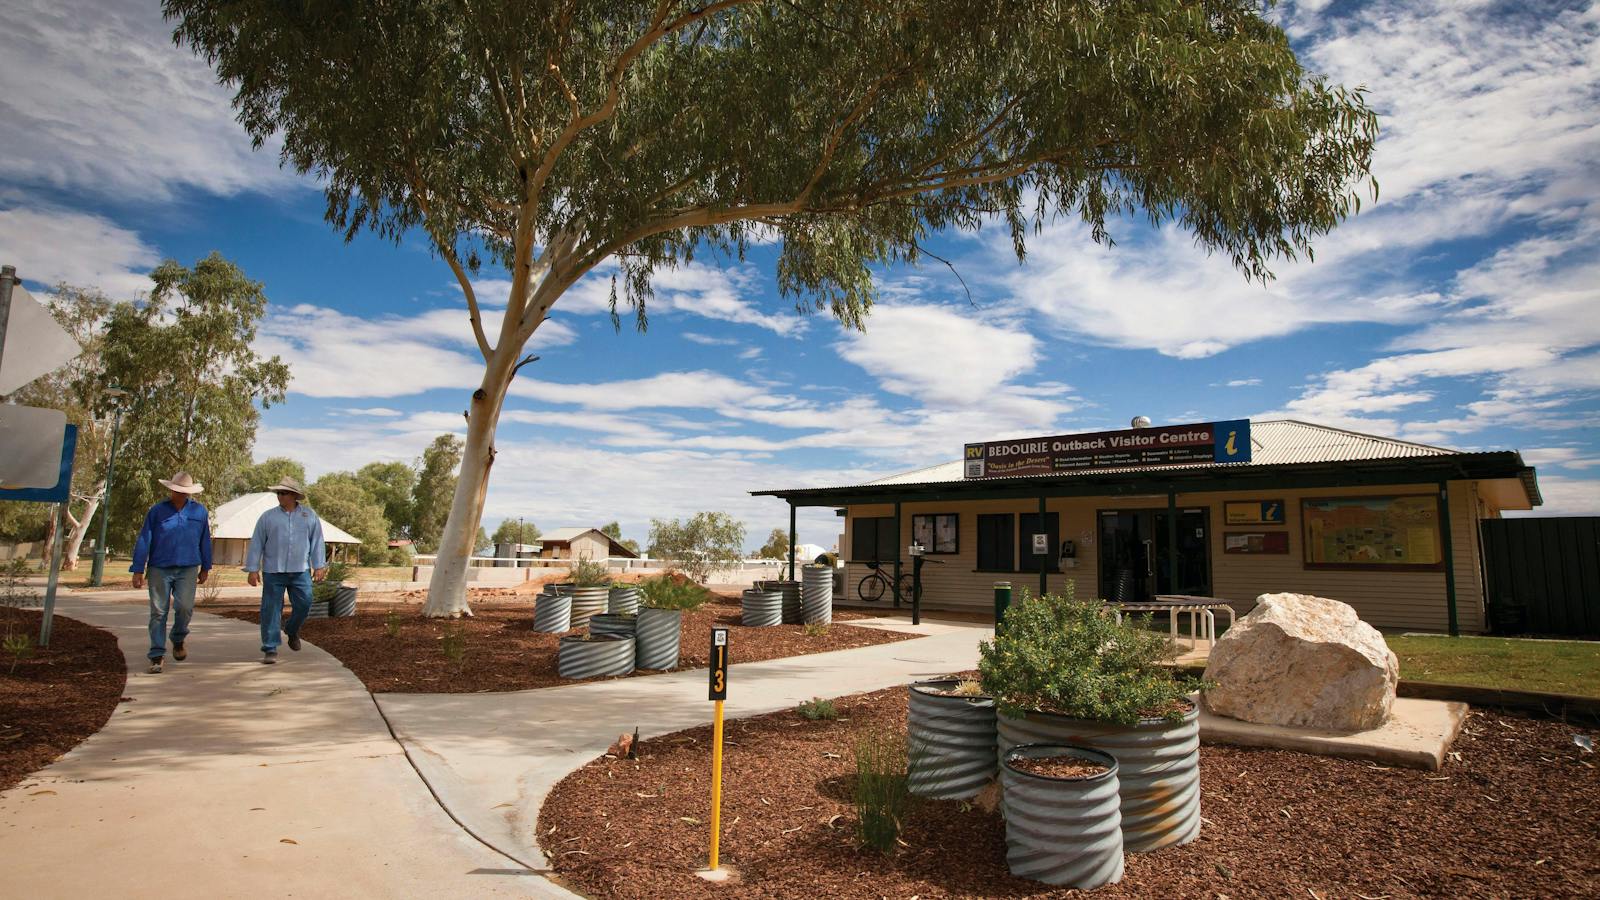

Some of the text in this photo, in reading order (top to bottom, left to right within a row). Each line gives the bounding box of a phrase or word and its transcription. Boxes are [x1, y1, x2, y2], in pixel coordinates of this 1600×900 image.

[967, 447, 983, 458] RV
[988, 431, 1208, 457] BEDOURIE Outback Visitor Centre
[713, 646, 725, 693] 13
